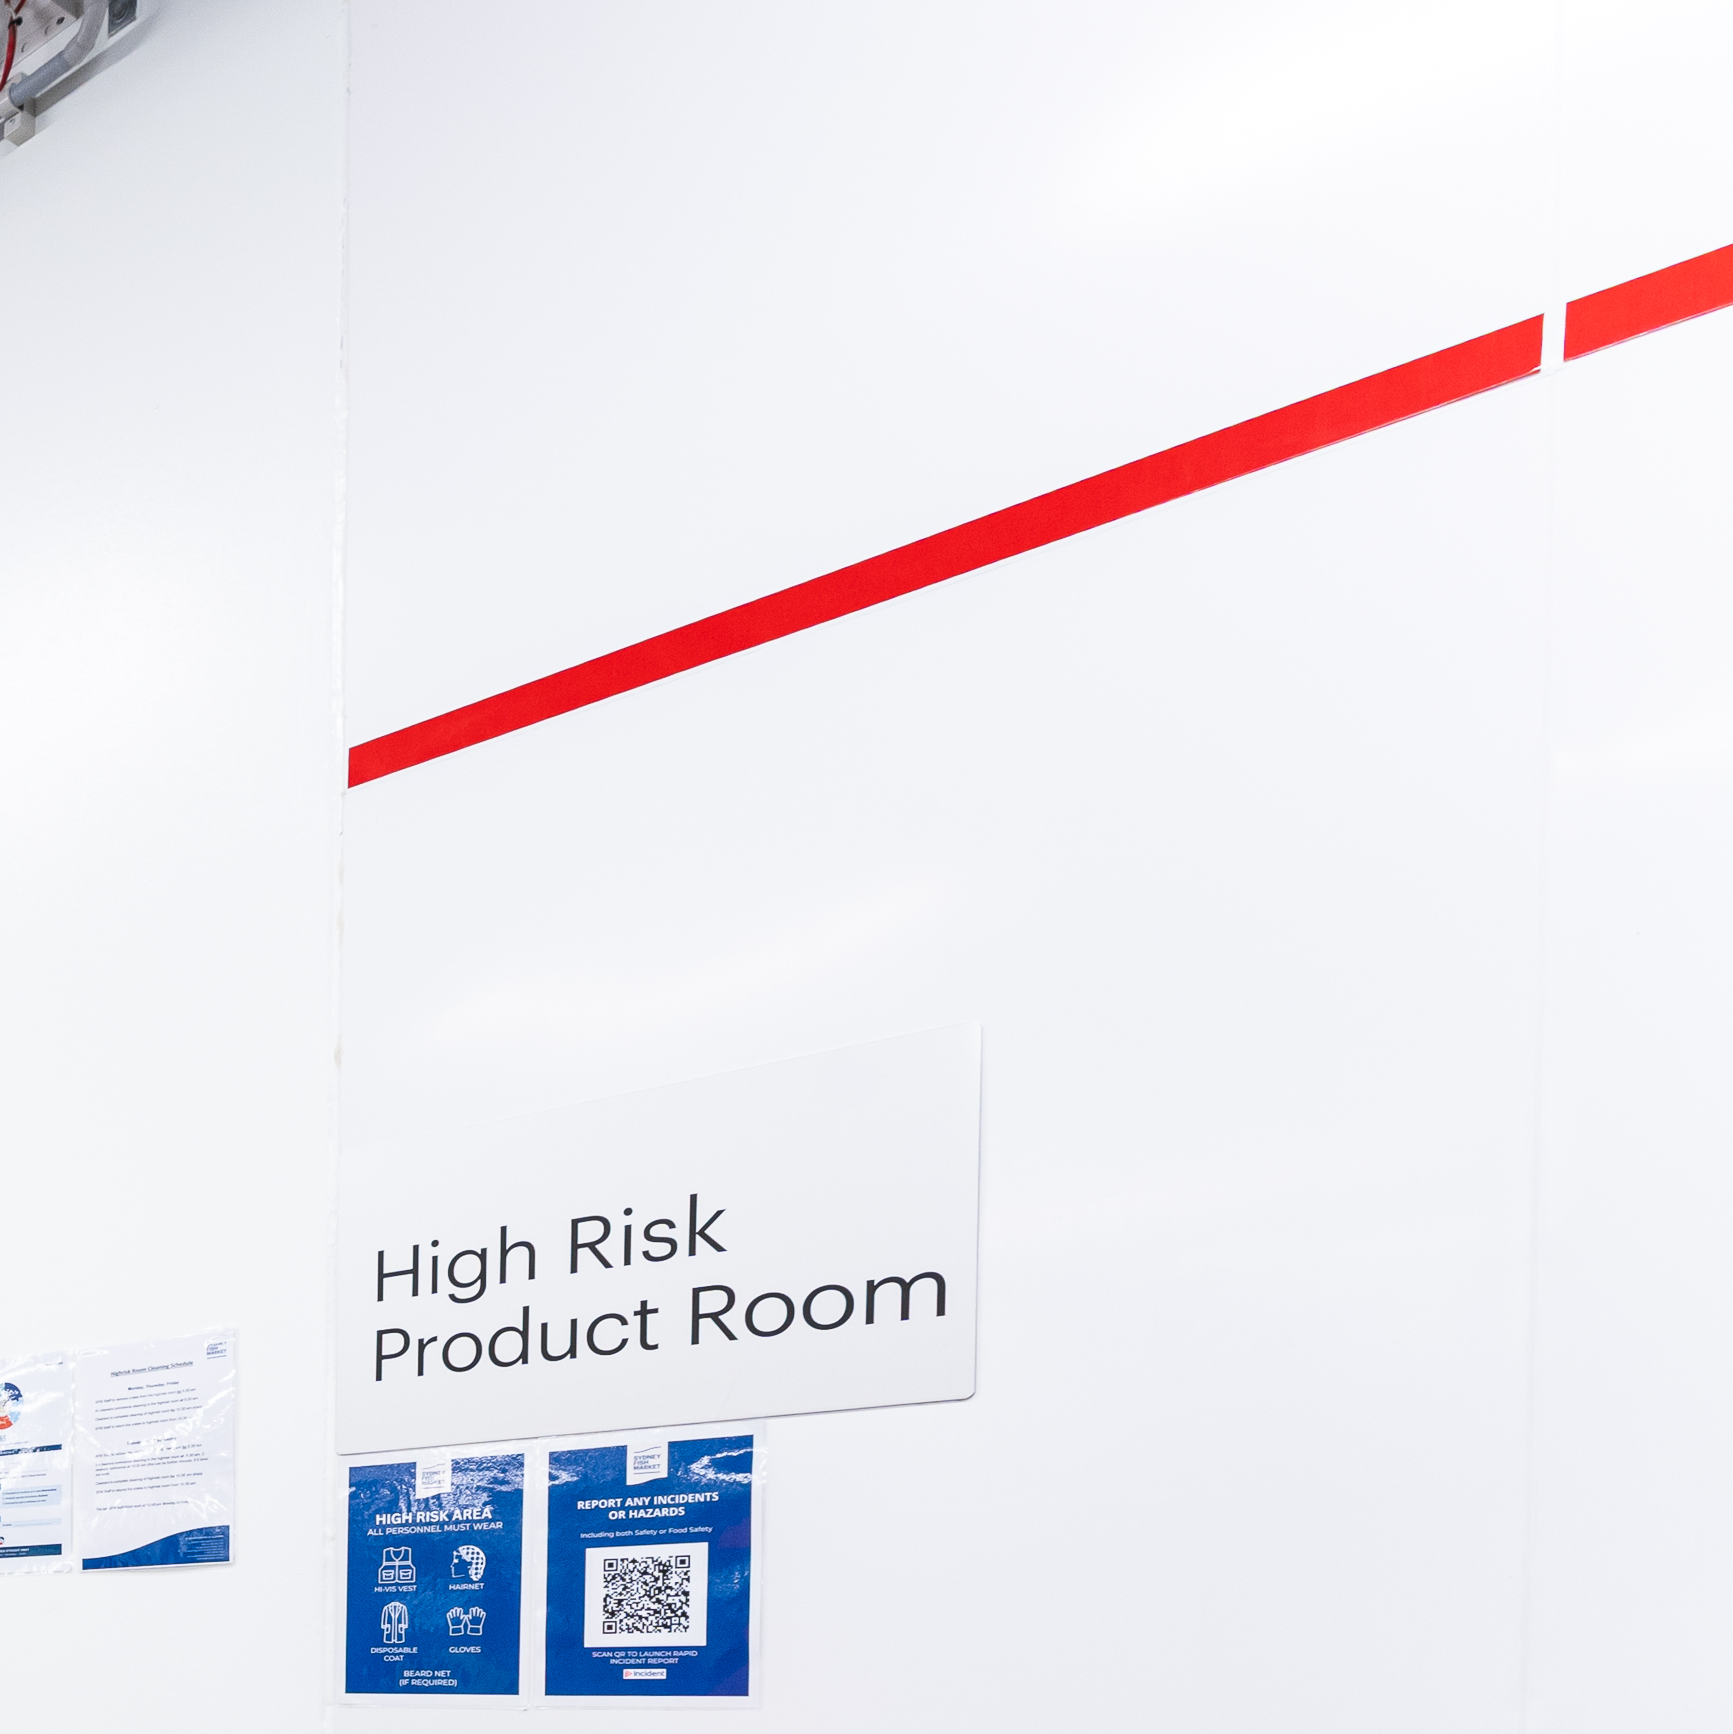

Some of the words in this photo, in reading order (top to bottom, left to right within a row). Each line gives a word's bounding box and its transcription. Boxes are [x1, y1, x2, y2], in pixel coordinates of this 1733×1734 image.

[376, 1225, 536, 1304] High
[569, 1193, 728, 1274] Risk
[375, 1298, 659, 1382] Product
[690, 1269, 947, 1346] Room
[577, 1498, 623, 1510] REPORT
[625, 1496, 651, 1507] ANY
[653, 1491, 720, 1506] INCIDENTS
[375, 1512, 413, 1526] HIGH
[416, 1510, 449, 1524] RISK
[452, 1507, 493, 1521] AREA
[608, 1510, 626, 1520] OR
[629, 1506, 685, 1519] HAZARDS
[367, 1528, 384, 1536] ALL
[386, 1524, 442, 1535] PERSONNEL
[443, 1522, 471, 1533] MUST
[472, 1521, 503, 1531] WEAR
[580, 1531, 614, 1539] Including
[615, 1529, 634, 1537] both
[634, 1528, 658, 1537] Safety
[668, 1526, 688, 1534] Food
[689, 1525, 713, 1534] Safety
[399, 1679, 410, 1687] (IF
[411, 1679, 458, 1687] REQUIRED)
